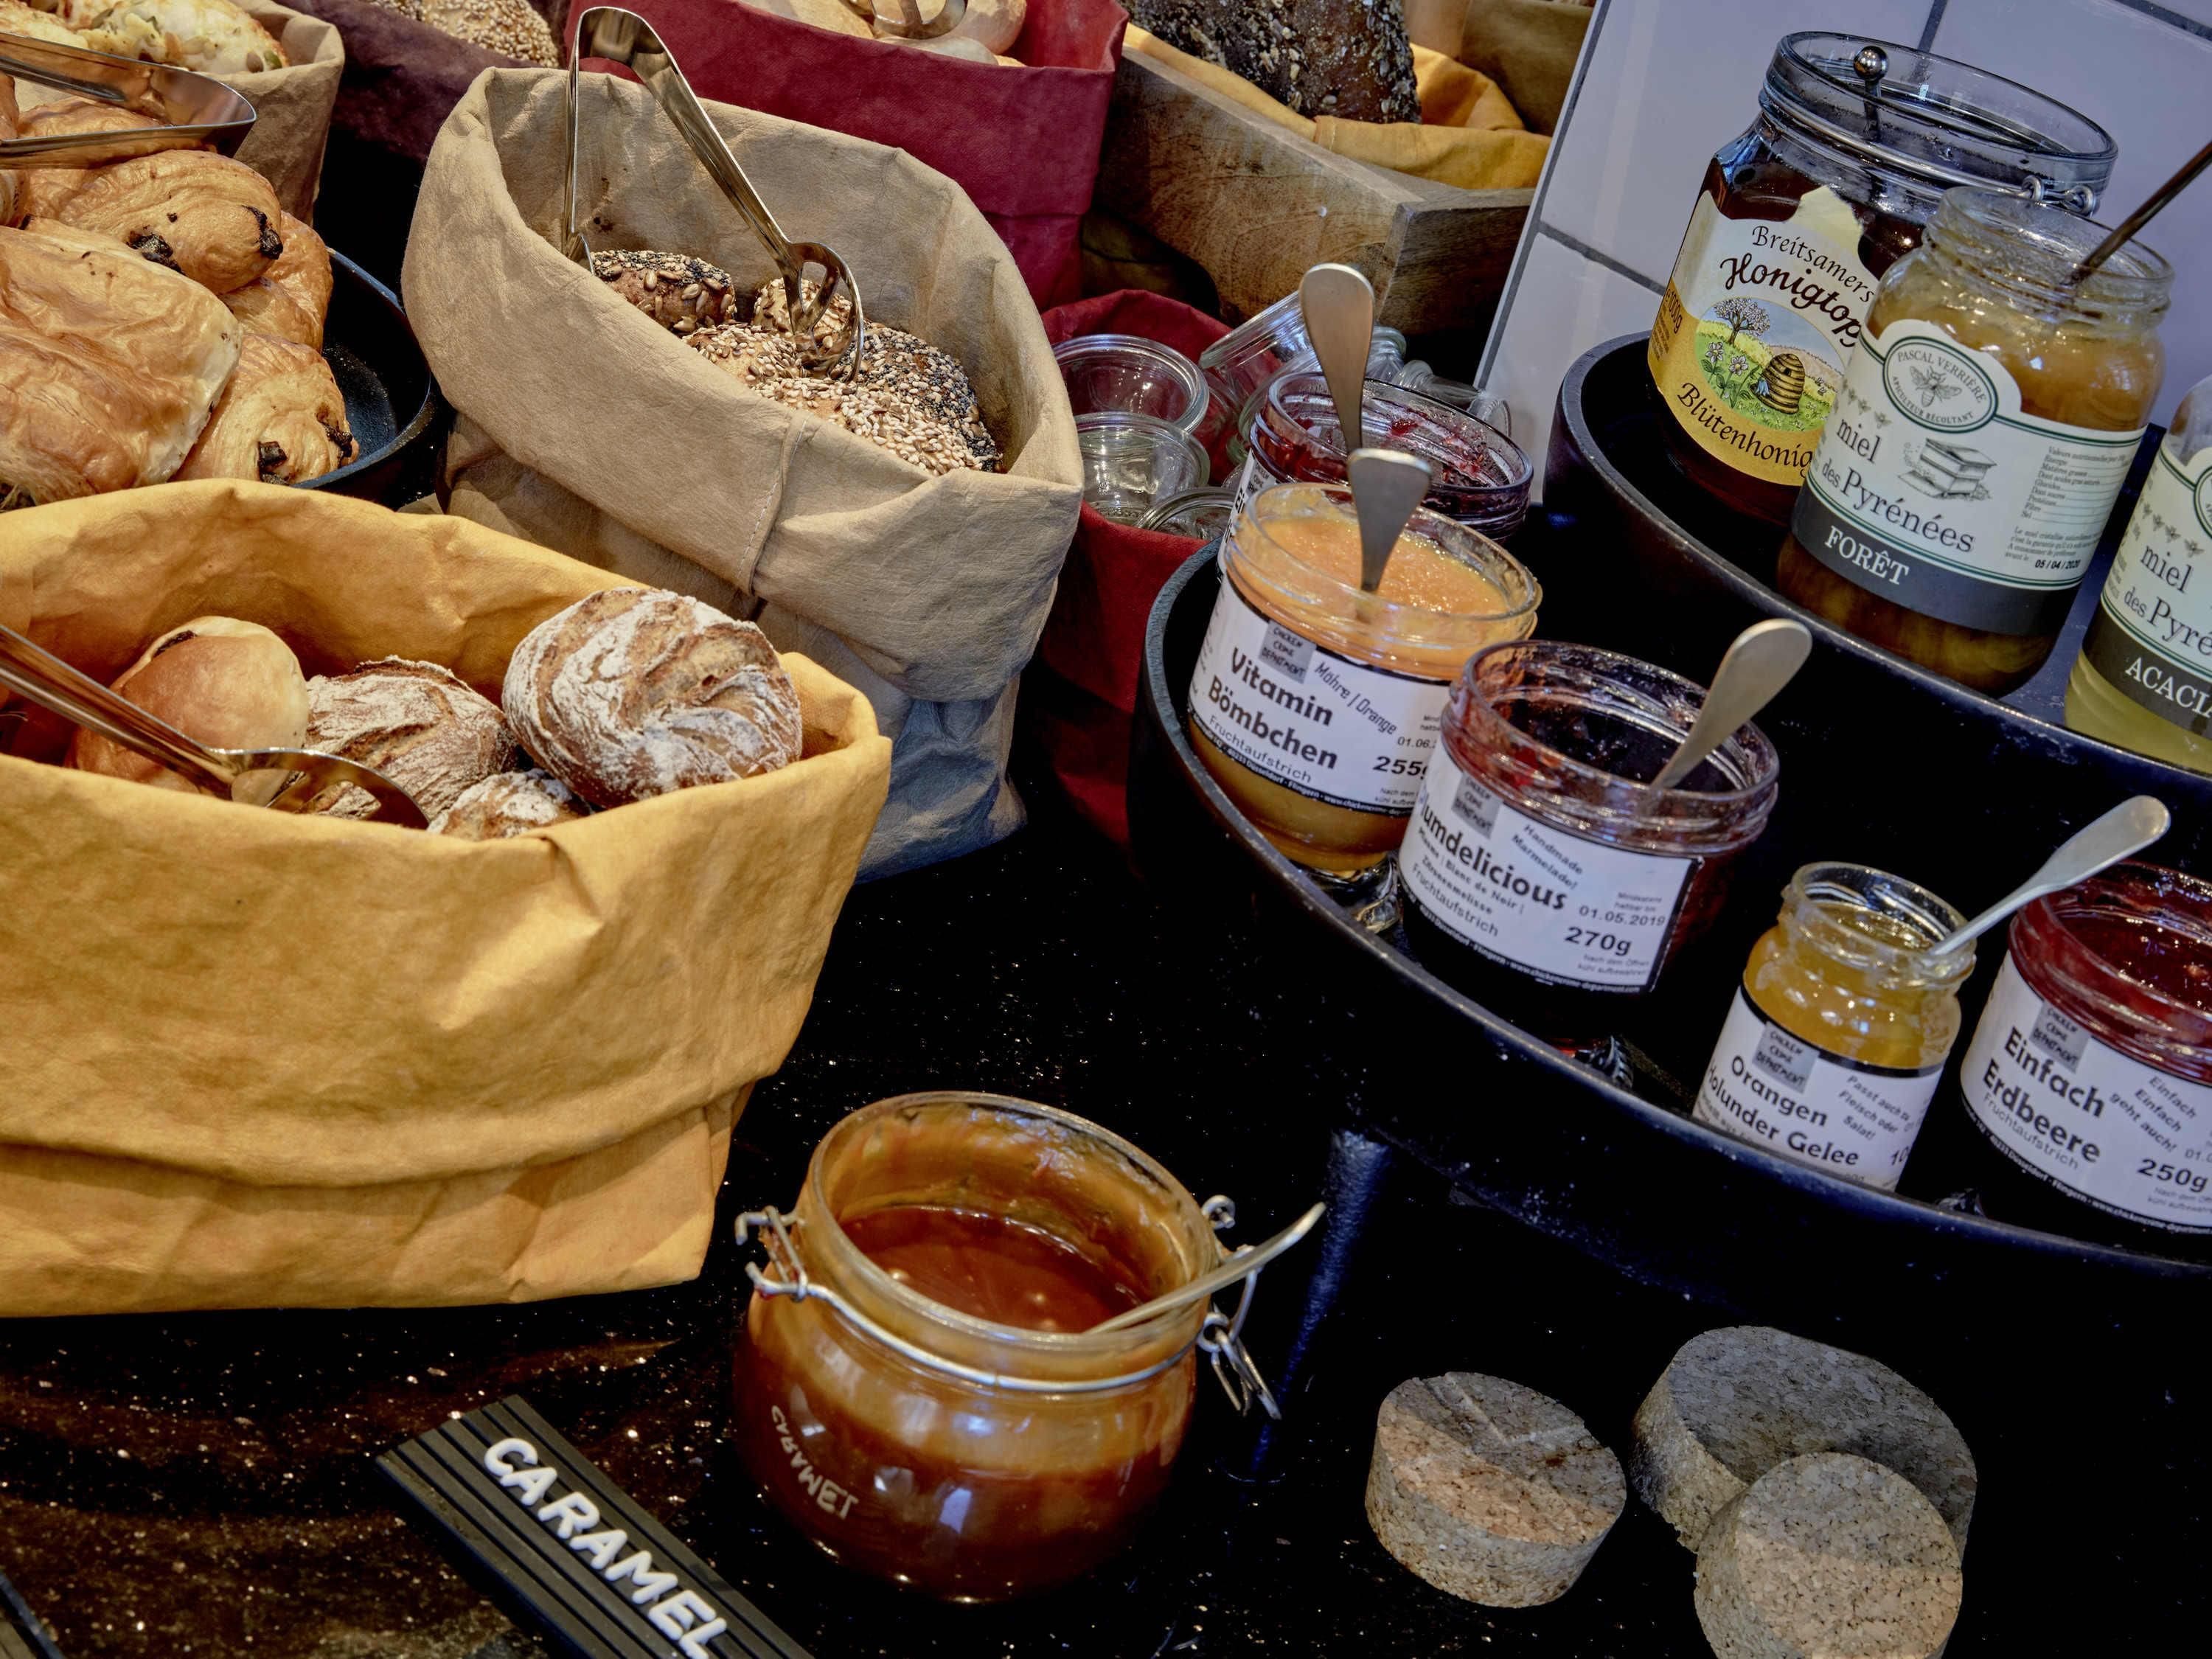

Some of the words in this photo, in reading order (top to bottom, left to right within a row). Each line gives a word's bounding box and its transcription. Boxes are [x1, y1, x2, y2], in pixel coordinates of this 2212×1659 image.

[1752, 225, 1875, 303] Breitsamers
[1720, 253, 1862, 347] Honigtop
[1897, 349, 1934, 364] PASCAL
[1938, 356, 1987, 403] VERRIÈRE
[1677, 383, 1813, 479] Blütenhonig
[1836, 419, 1882, 465] miel
[1822, 458, 1841, 488] des
[1840, 467, 1975, 553] Pyrénées
[1825, 526, 1910, 585] FORÊT
[2140, 545, 2194, 594] miel
[2124, 586, 2148, 618] des
[2147, 597, 2212, 656] Pyré
[1231, 647, 1334, 726] Vitamin
[1208, 675, 1338, 770] Bömbchen
[1355, 698, 1397, 735] Orange
[1209, 714, 1312, 784] Fruchtaufstrich
[1524, 824, 1583, 875] Handmade
[1412, 863, 1500, 938] Fruchtaufstrich
[1579, 904, 1666, 927] 01.05.2019
[1565, 925, 1632, 956] 270g
[1731, 1054, 1828, 1127] Orangen
[1847, 1075, 1879, 1102] Passt
[1878, 1099, 1901, 1116] auch
[2004, 1026, 2104, 1119] Einfach
[2149, 1076, 2197, 1119] Einfach
[1839, 1090, 1878, 1121] Fleisch
[1878, 1119, 1898, 1133] oder
[1843, 1115, 1876, 1141] Salat!
[1983, 1057, 2100, 1164] Erdbeere
[1983, 1092, 2079, 1170] Fruchtaufstrich
[2110, 1093, 2140, 1122] geht
[2140, 1121, 2177, 1152] auch!
[2135, 1088, 2182, 1132] Einfach
[1787, 1130, 1859, 1166] Gelee
[2138, 1158, 2208, 1193] 250g
[484, 1437, 727, 1659] CARAMEL
